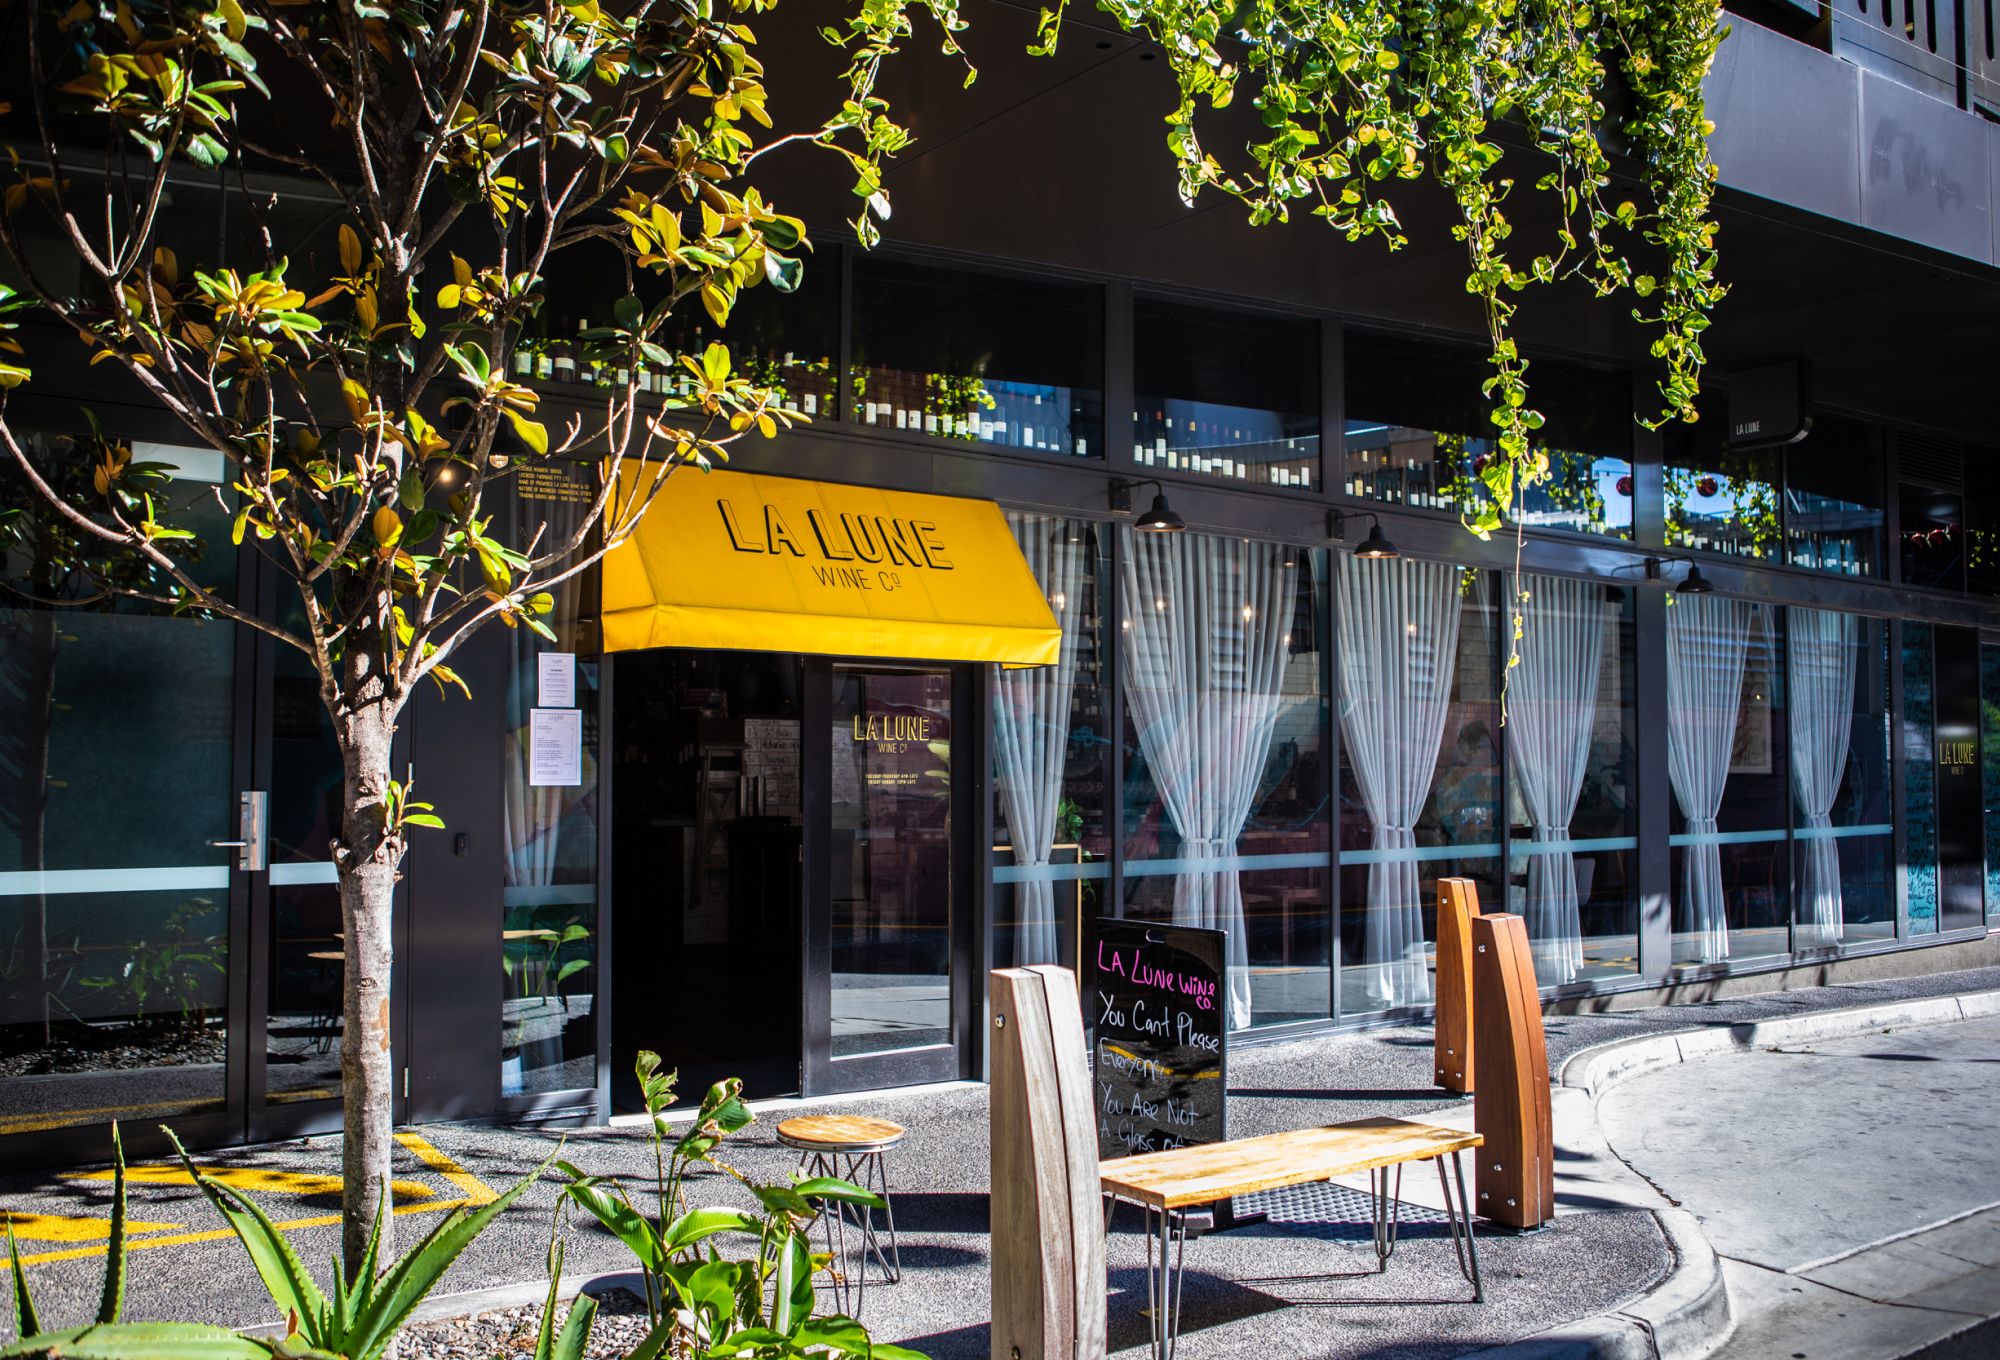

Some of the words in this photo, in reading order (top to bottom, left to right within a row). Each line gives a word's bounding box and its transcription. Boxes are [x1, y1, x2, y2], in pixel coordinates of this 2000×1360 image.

[1736, 424, 1744, 435] LA
[1745, 421, 1760, 433] LUNE
[717, 499, 806, 557] LA
[807, 509, 954, 570] LUNE
[811, 565, 872, 590] WINE
[854, 714, 878, 741] LA
[883, 715, 930, 742] LUNE
[878, 743, 897, 754] WINE
[1939, 742, 1952, 765] LA
[1952, 742, 1975, 765] LUNE
[1098, 940, 1125, 977] LA
[1099, 991, 1125, 1027] You
[1132, 1000, 1170, 1037] Cant
[1177, 1011, 1220, 1053] Please
[1100, 1081, 1124, 1115] You
[1167, 1098, 1199, 1127] Not
[1100, 1119, 1111, 1139] A
[1118, 1120, 1155, 1153] Glass
